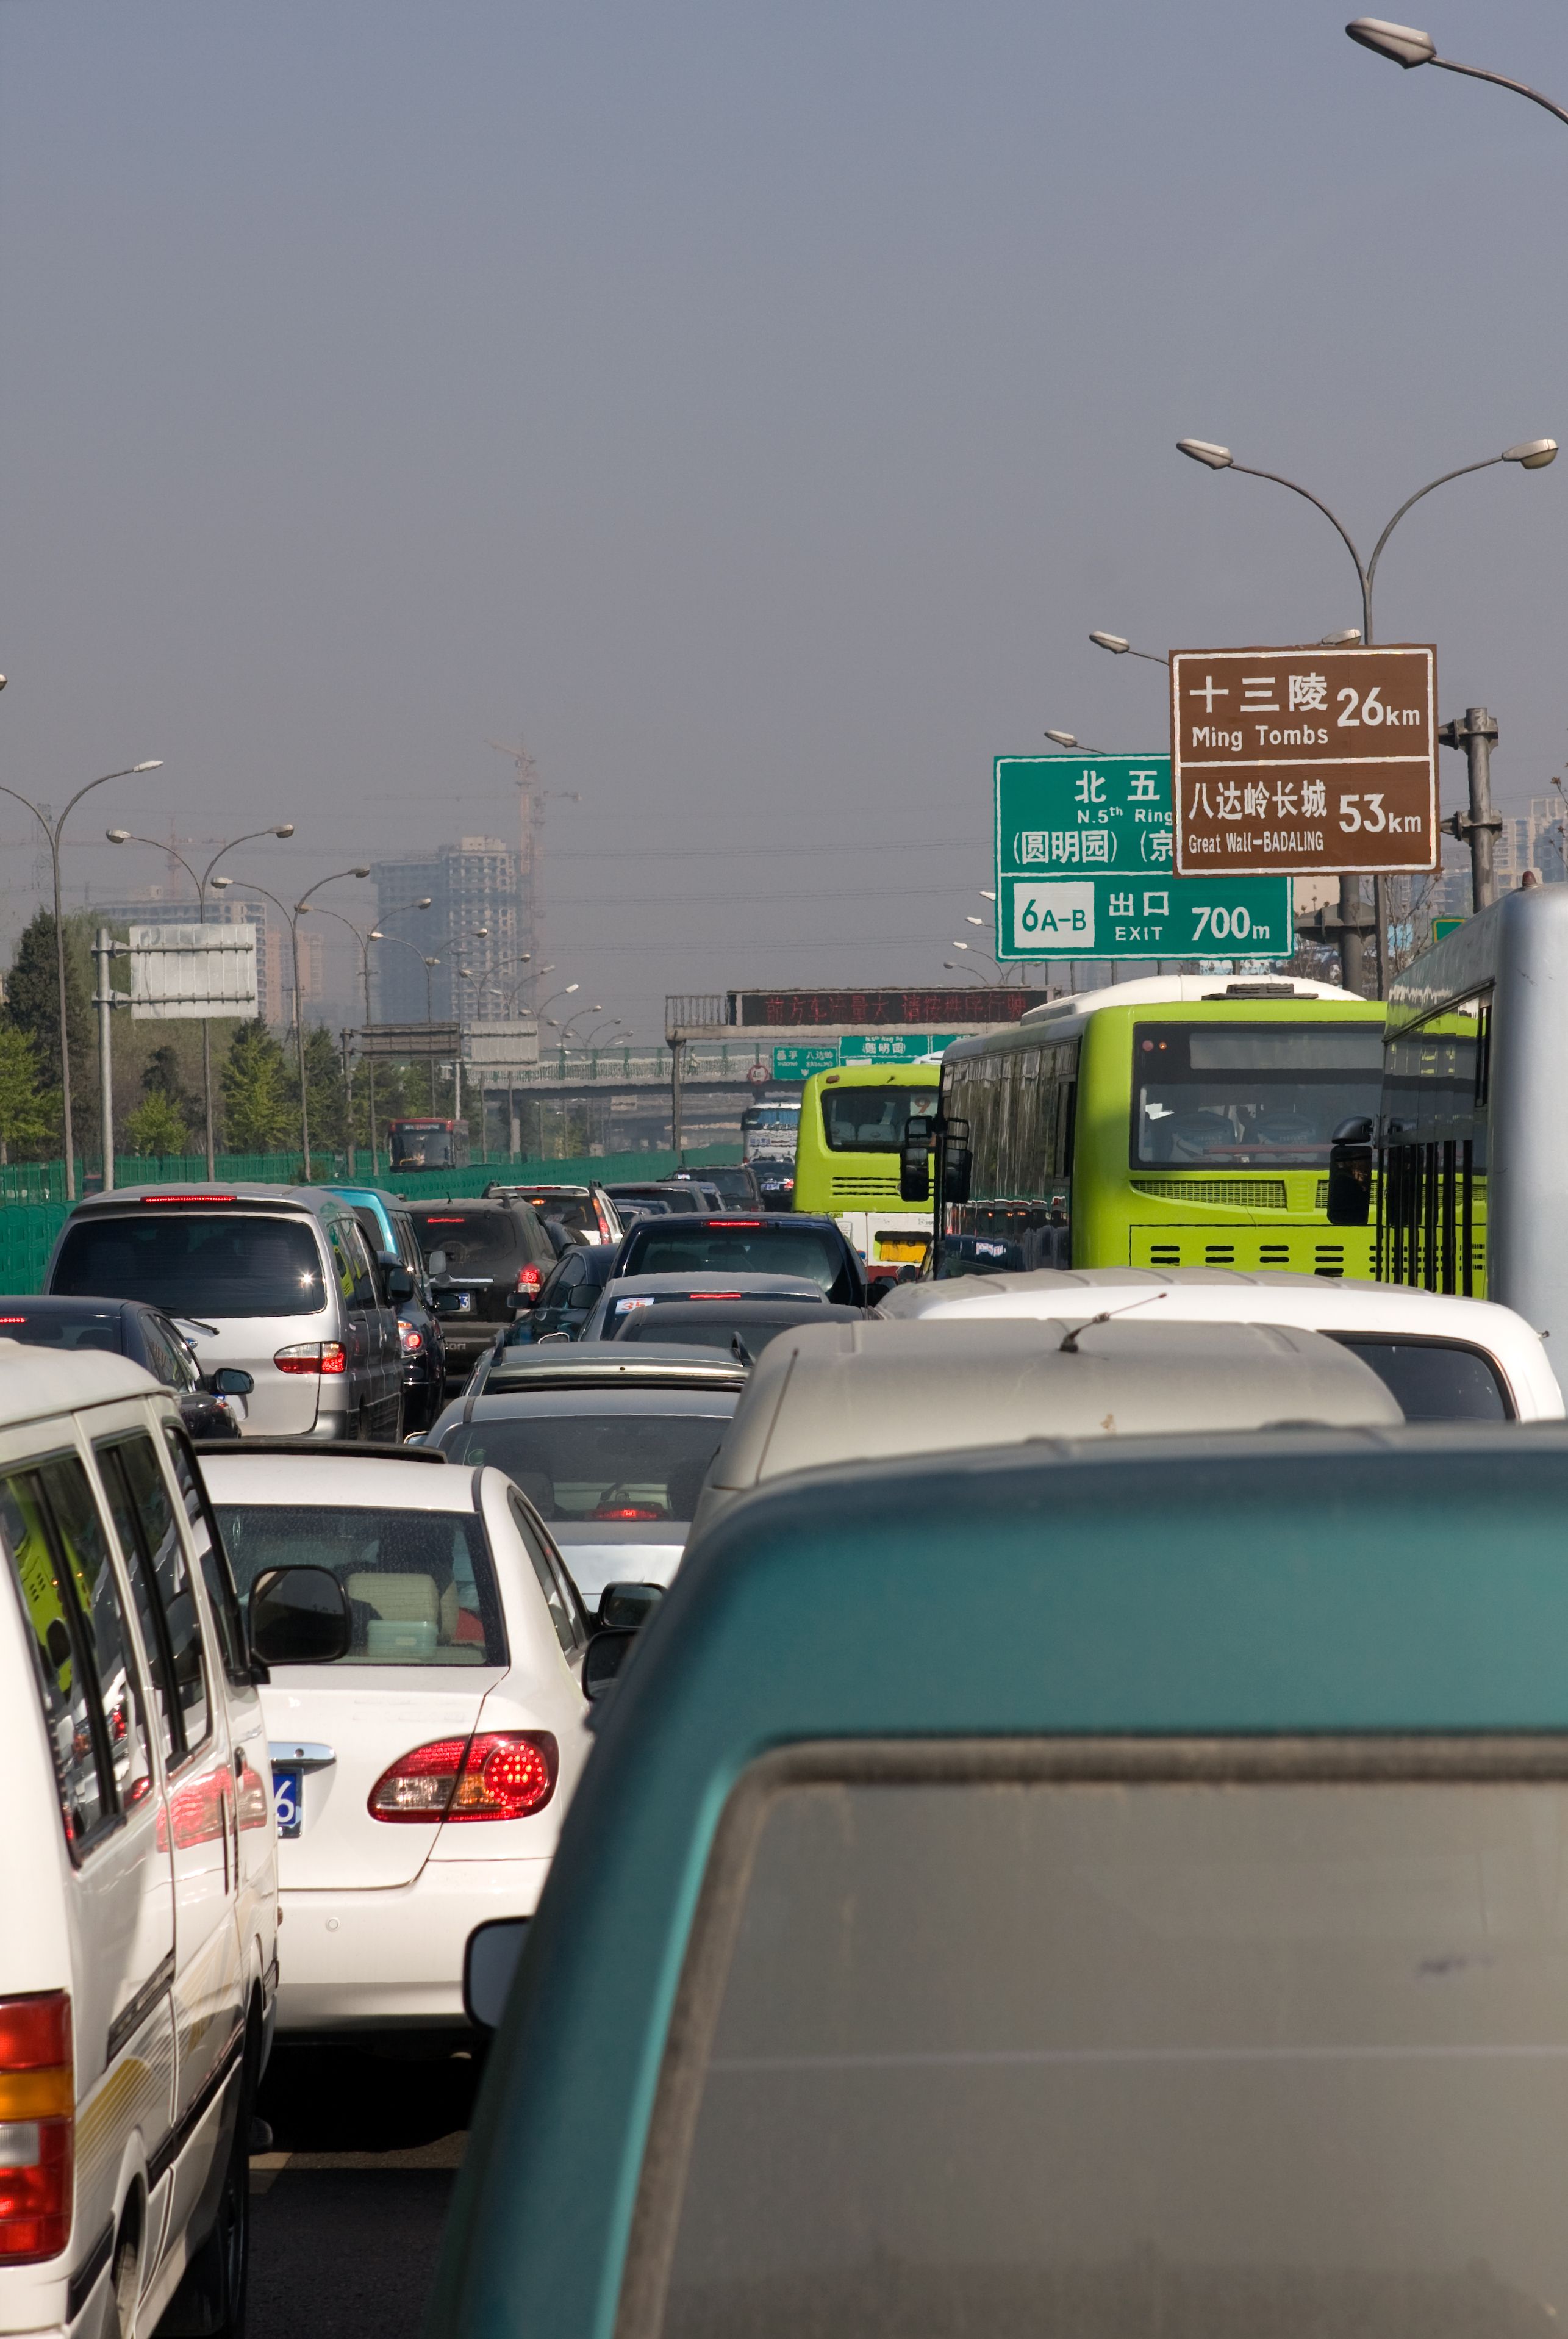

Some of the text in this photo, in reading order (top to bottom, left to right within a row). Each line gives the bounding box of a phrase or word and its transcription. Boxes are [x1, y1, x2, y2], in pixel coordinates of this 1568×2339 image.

[1190, 672, 1328, 713] 十三陵
[1192, 724, 1328, 752] Ming Tombs
[1189, 779, 1327, 821] 八达岭长城
[1077, 806, 1172, 826] N.5th Ring
[1014, 830, 1117, 864] (圆明园)
[1189, 834, 1221, 854] Great
[1022, 899, 1087, 933] 6A-B
[1108, 891, 1169, 917] 出口
[1115, 926, 1164, 941] EXIT
[915, 1097, 931, 1113] 9
[274, 1780, 295, 1823] 6
